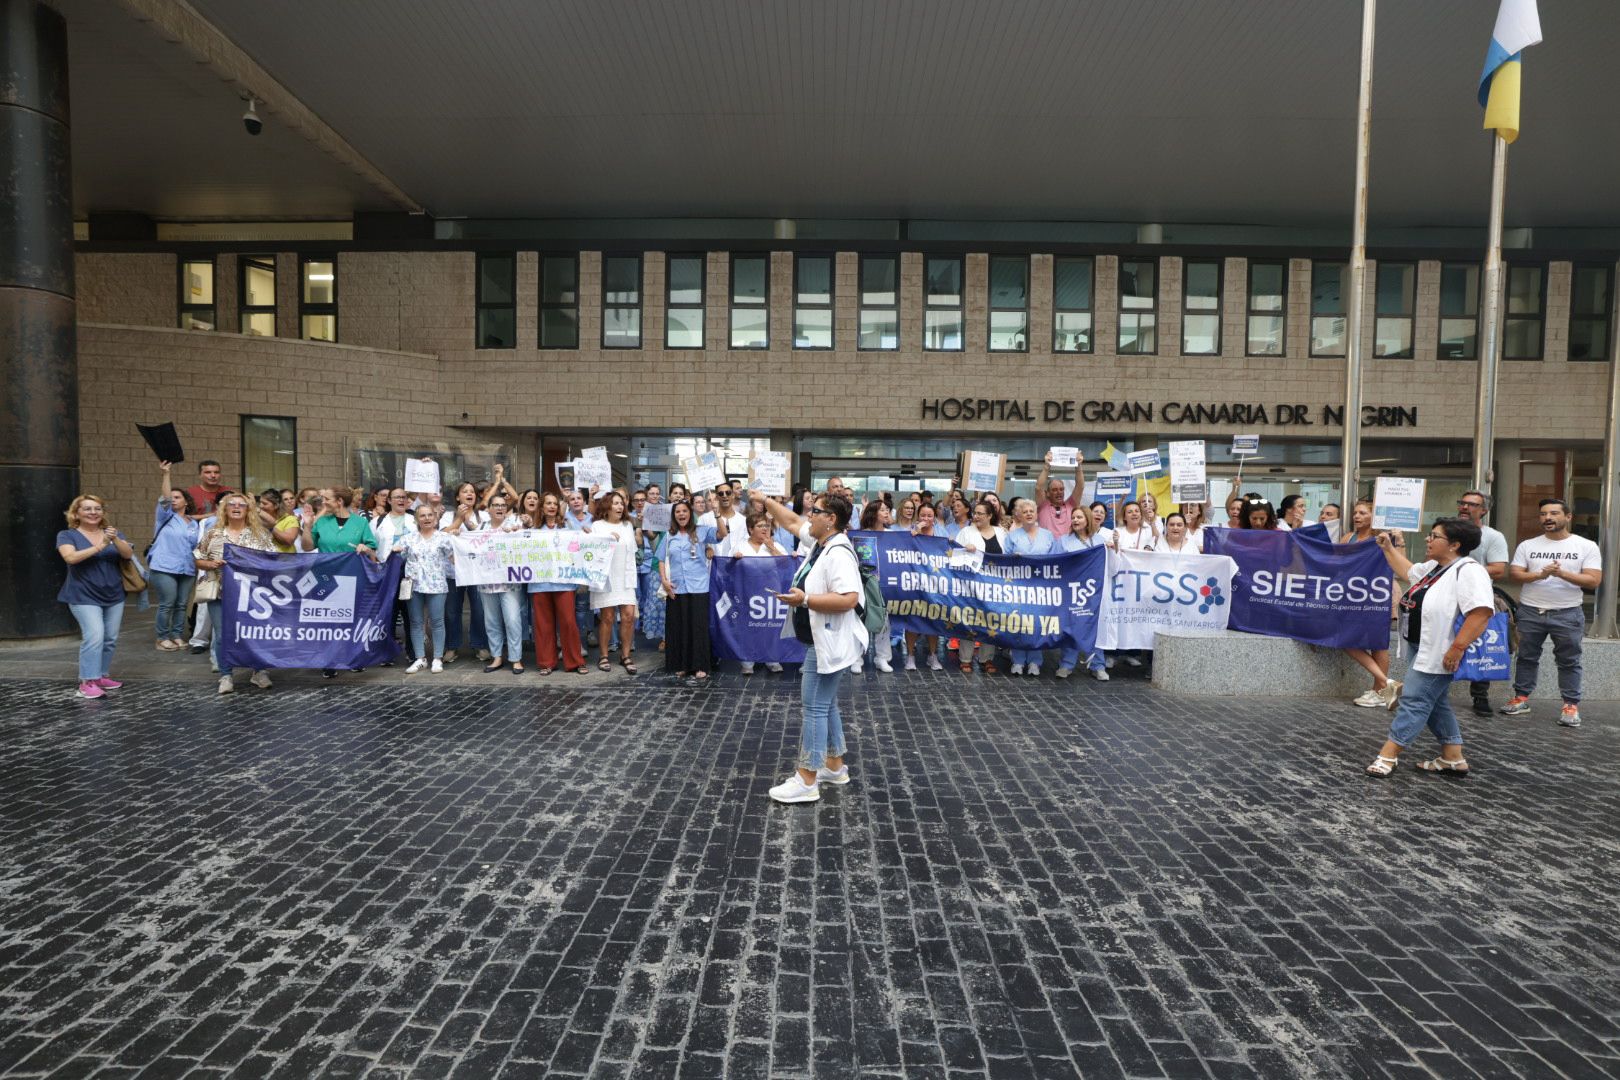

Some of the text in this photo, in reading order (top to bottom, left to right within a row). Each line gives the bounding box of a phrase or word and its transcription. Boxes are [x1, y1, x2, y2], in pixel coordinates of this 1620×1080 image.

[922, 398, 1035, 421] HOSPITAL
[1043, 400, 1075, 422] DE
[1081, 401, 1153, 423] GRAN
[1162, 402, 1269, 425] CANARIA
[1324, 405, 1418, 427] NGRIN
[507, 566, 533, 581] NO
[886, 548, 928, 566] TÉCNICO
[1043, 565, 1062, 579] U.E.
[233, 571, 293, 620] TSS
[901, 571, 948, 595] GRADO
[952, 577, 1062, 607] UNIVERSITARIO
[1068, 578, 1097, 607] TSS
[1251, 570, 1391, 603] SIETeSS
[302, 607, 352, 618] SIETeSS
[887, 599, 1060, 635] HOMOLOGACIÓN YA
[235, 621, 291, 643] Juntos
[297, 627, 351, 642] somos
